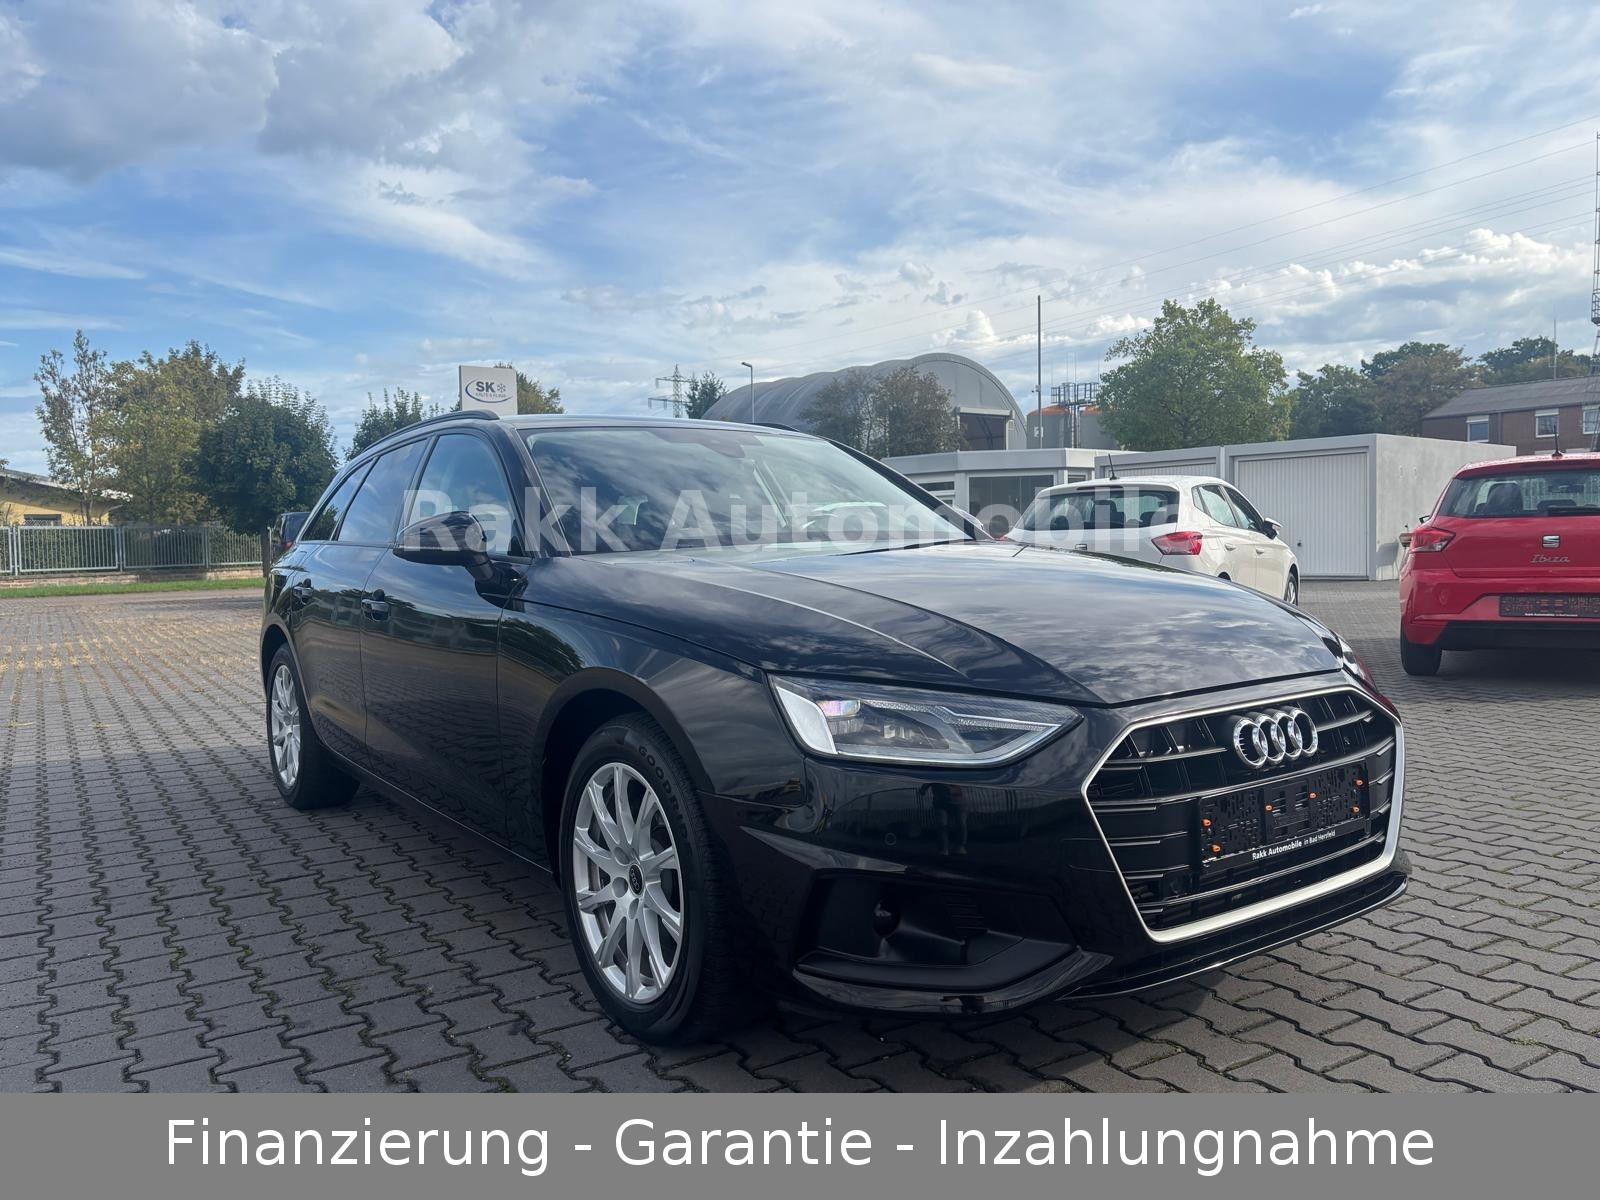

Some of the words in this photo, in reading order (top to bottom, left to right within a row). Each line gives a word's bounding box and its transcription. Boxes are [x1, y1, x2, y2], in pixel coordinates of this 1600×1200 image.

[475, 381, 495, 393] SK
[1530, 554, 1570, 563] Ibiza
[1252, 850, 1267, 860] Rakk
[1268, 840, 1302, 856] Automobile
